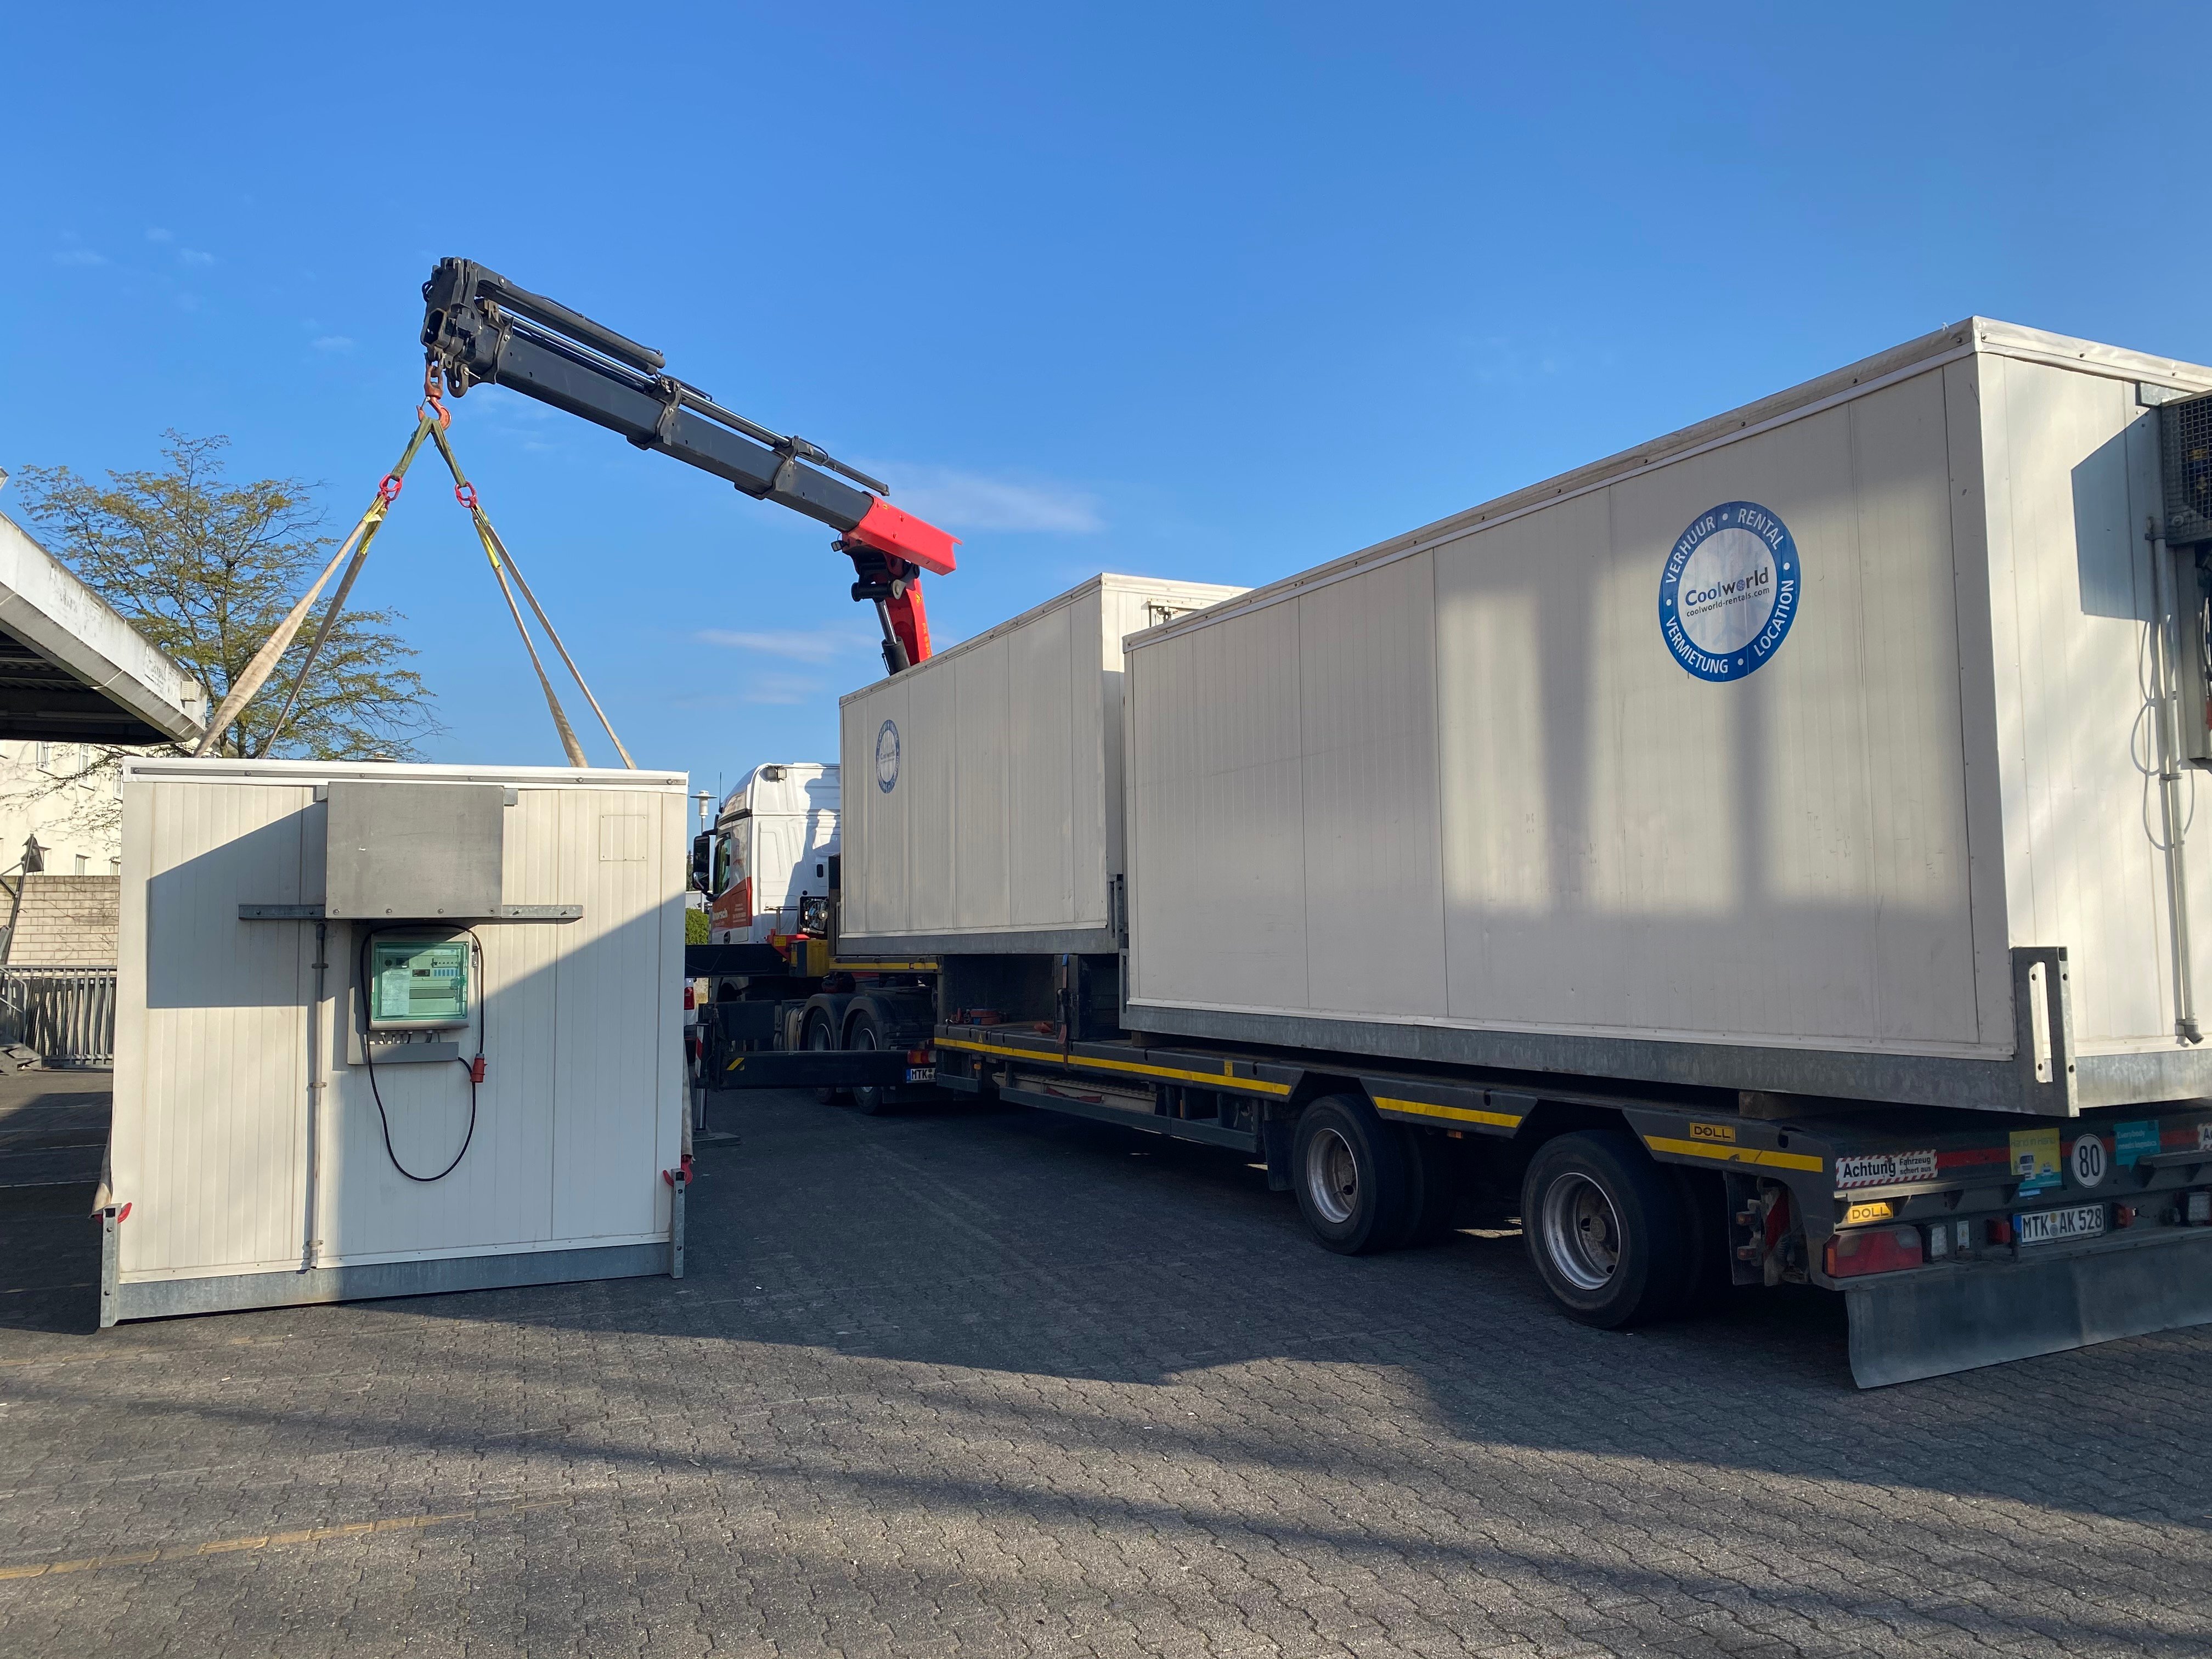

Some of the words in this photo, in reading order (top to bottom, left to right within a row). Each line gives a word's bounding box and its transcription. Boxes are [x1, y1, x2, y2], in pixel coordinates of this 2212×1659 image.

[1738, 508, 1784, 550] RENTAL
[1666, 516, 1715, 583] VERHUUR
[1685, 567, 1769, 606] Coolworld
[1686, 588, 1770, 617] coolworld-rentals.com
[1753, 579, 1795, 657] LOCATION
[1666, 616, 1729, 674] VERMIETUNG
[911, 1069, 927, 1080] MTK
[1694, 1126, 1731, 1138] DOLL
[2203, 1127, 2212, 1141] A
[1843, 1160, 1896, 1177] Achtung
[1899, 1157, 1931, 1166] Fahrzeug
[1900, 1166, 1919, 1175] schert
[2079, 1144, 2101, 1178] 80
[1852, 1206, 1889, 1220] DOLL
[2023, 1215, 2049, 1239] MTK
[2059, 1211, 2076, 1233] AK
[2078, 1207, 2102, 1231] 528
